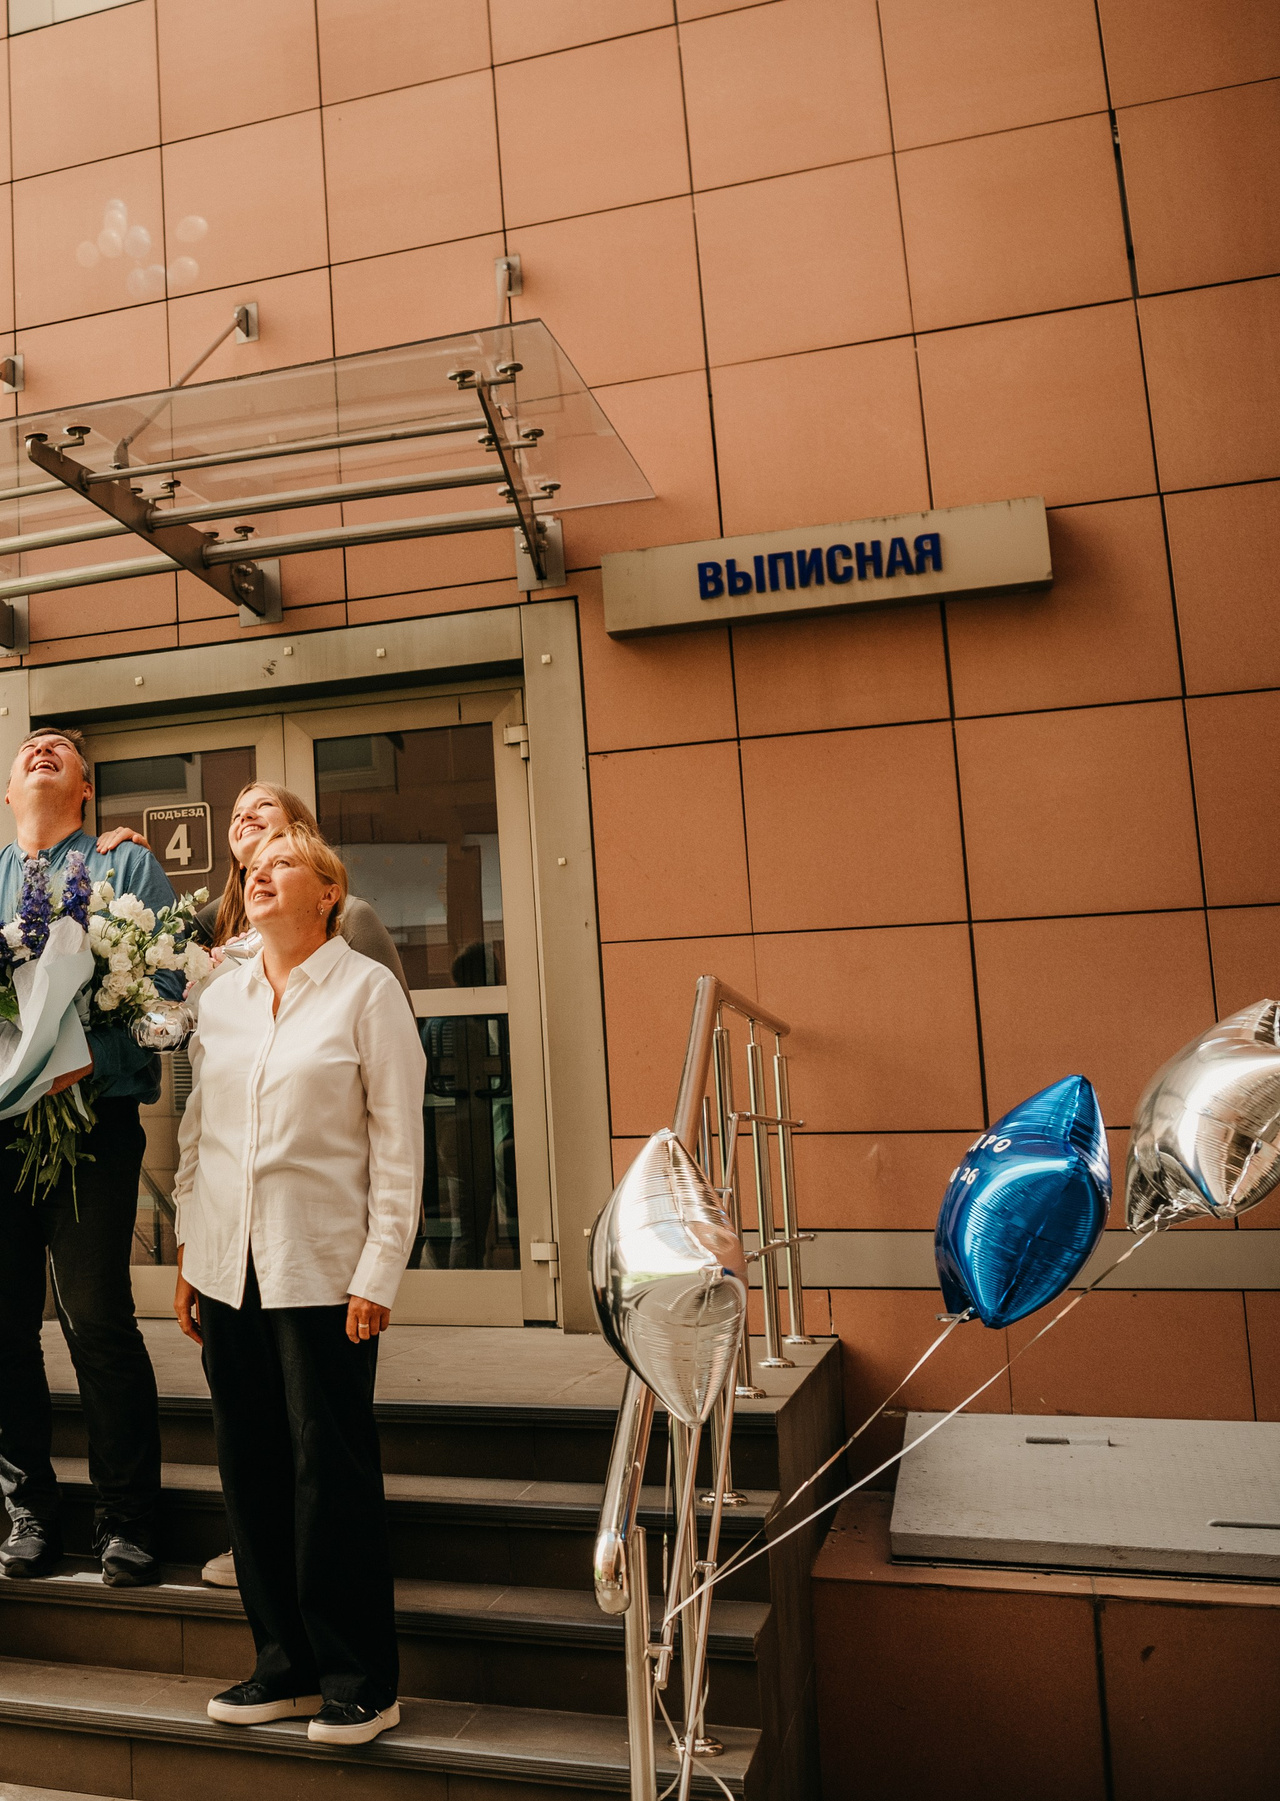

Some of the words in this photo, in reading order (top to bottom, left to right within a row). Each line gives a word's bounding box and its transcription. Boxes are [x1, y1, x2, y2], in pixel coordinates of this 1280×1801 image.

[697, 532, 943, 601] ВЫПИСНАЯ
[149, 807, 205, 820] ПОДЪЕЗД
[165, 823, 192, 866] 4
